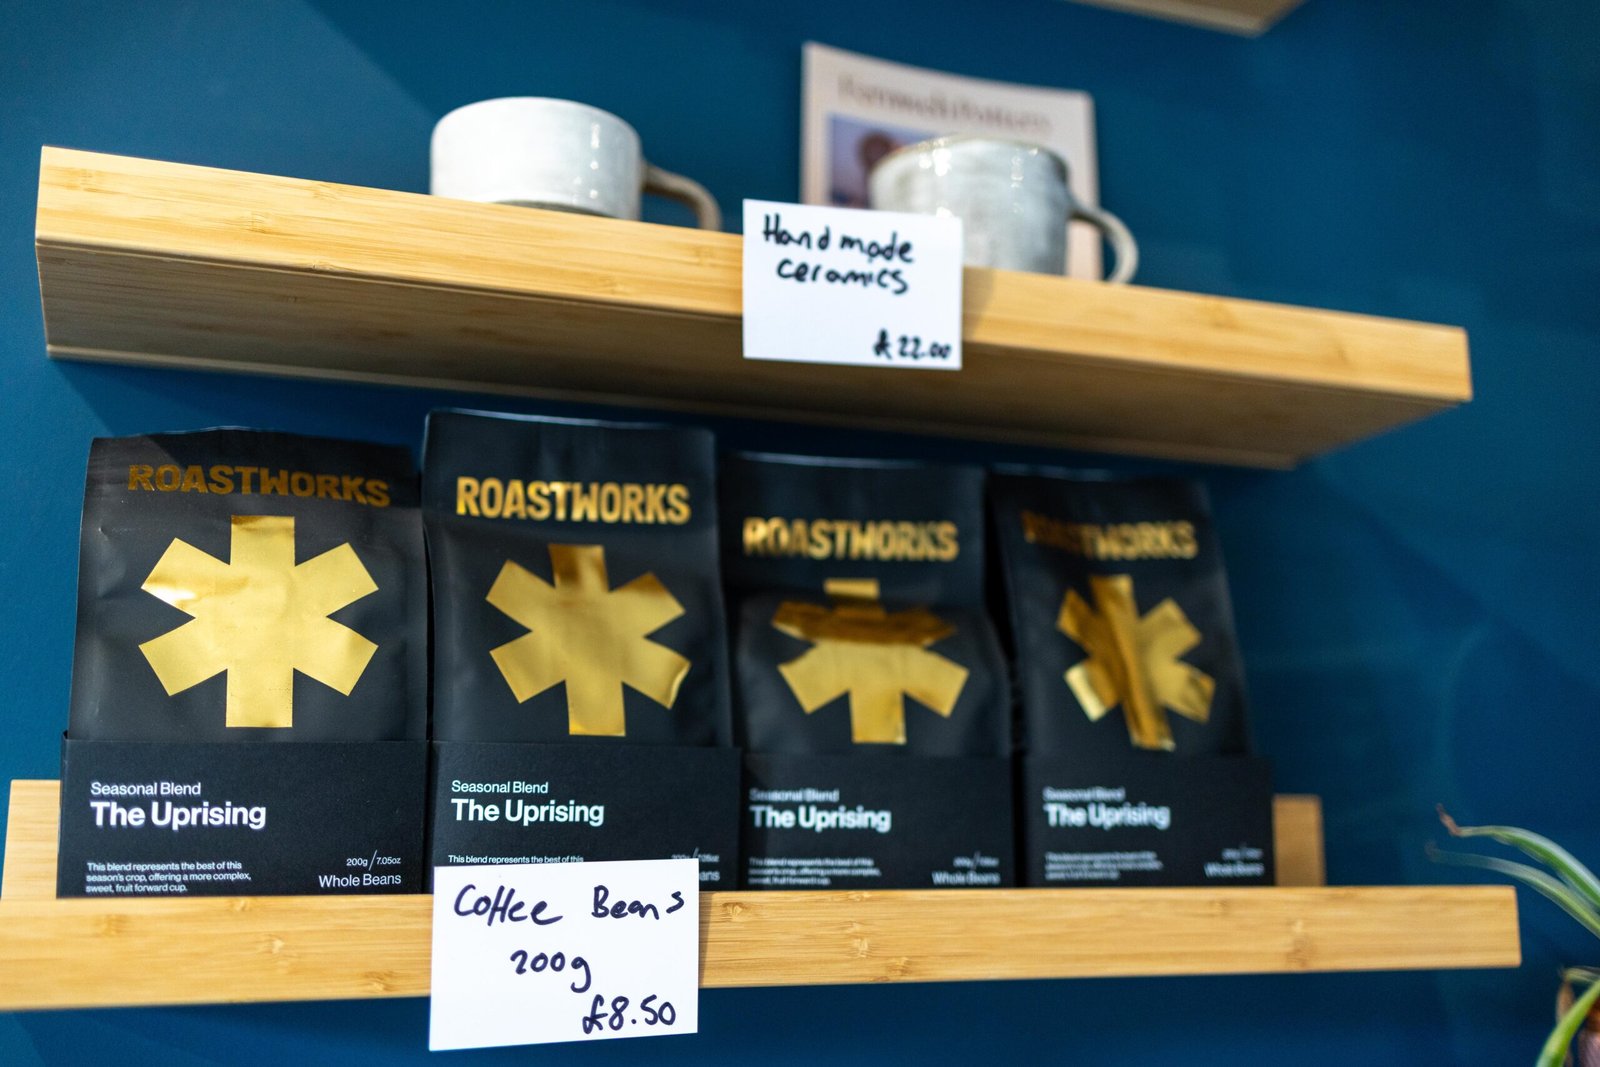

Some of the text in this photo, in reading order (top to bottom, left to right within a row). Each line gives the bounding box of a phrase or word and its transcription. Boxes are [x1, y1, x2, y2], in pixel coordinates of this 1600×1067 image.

[777, 258, 908, 295] ceramics
[127, 464, 391, 508] ROASTWORKS
[456, 476, 692, 525] ROASTWORKS
[742, 517, 959, 562] ROASTWORKS
[90, 781, 202, 796] Seasonal Blend
[451, 780, 549, 794] Seasonal Blend
[90, 801, 267, 831] The Uprising
[450, 798, 605, 827] The Uprising
[749, 805, 892, 833] The Uprising
[1043, 802, 1171, 830] The Uprising
[87, 861, 242, 872] This blend represents the best of this
[448, 855, 465, 864] This
[465, 855, 488, 864] blend
[488, 856, 530, 865] represents
[115, 884, 134, 893] fruit
[134, 883, 169, 893] forward
[148, 873, 182, 882] offering
[183, 873, 189, 881] a
[189, 873, 213, 881] more
[319, 873, 402, 888] Whole Beans
[453, 884, 685, 926] Coffee Beans
[509, 950, 592, 993] 200g
[582, 994, 676, 1034] £8.50
